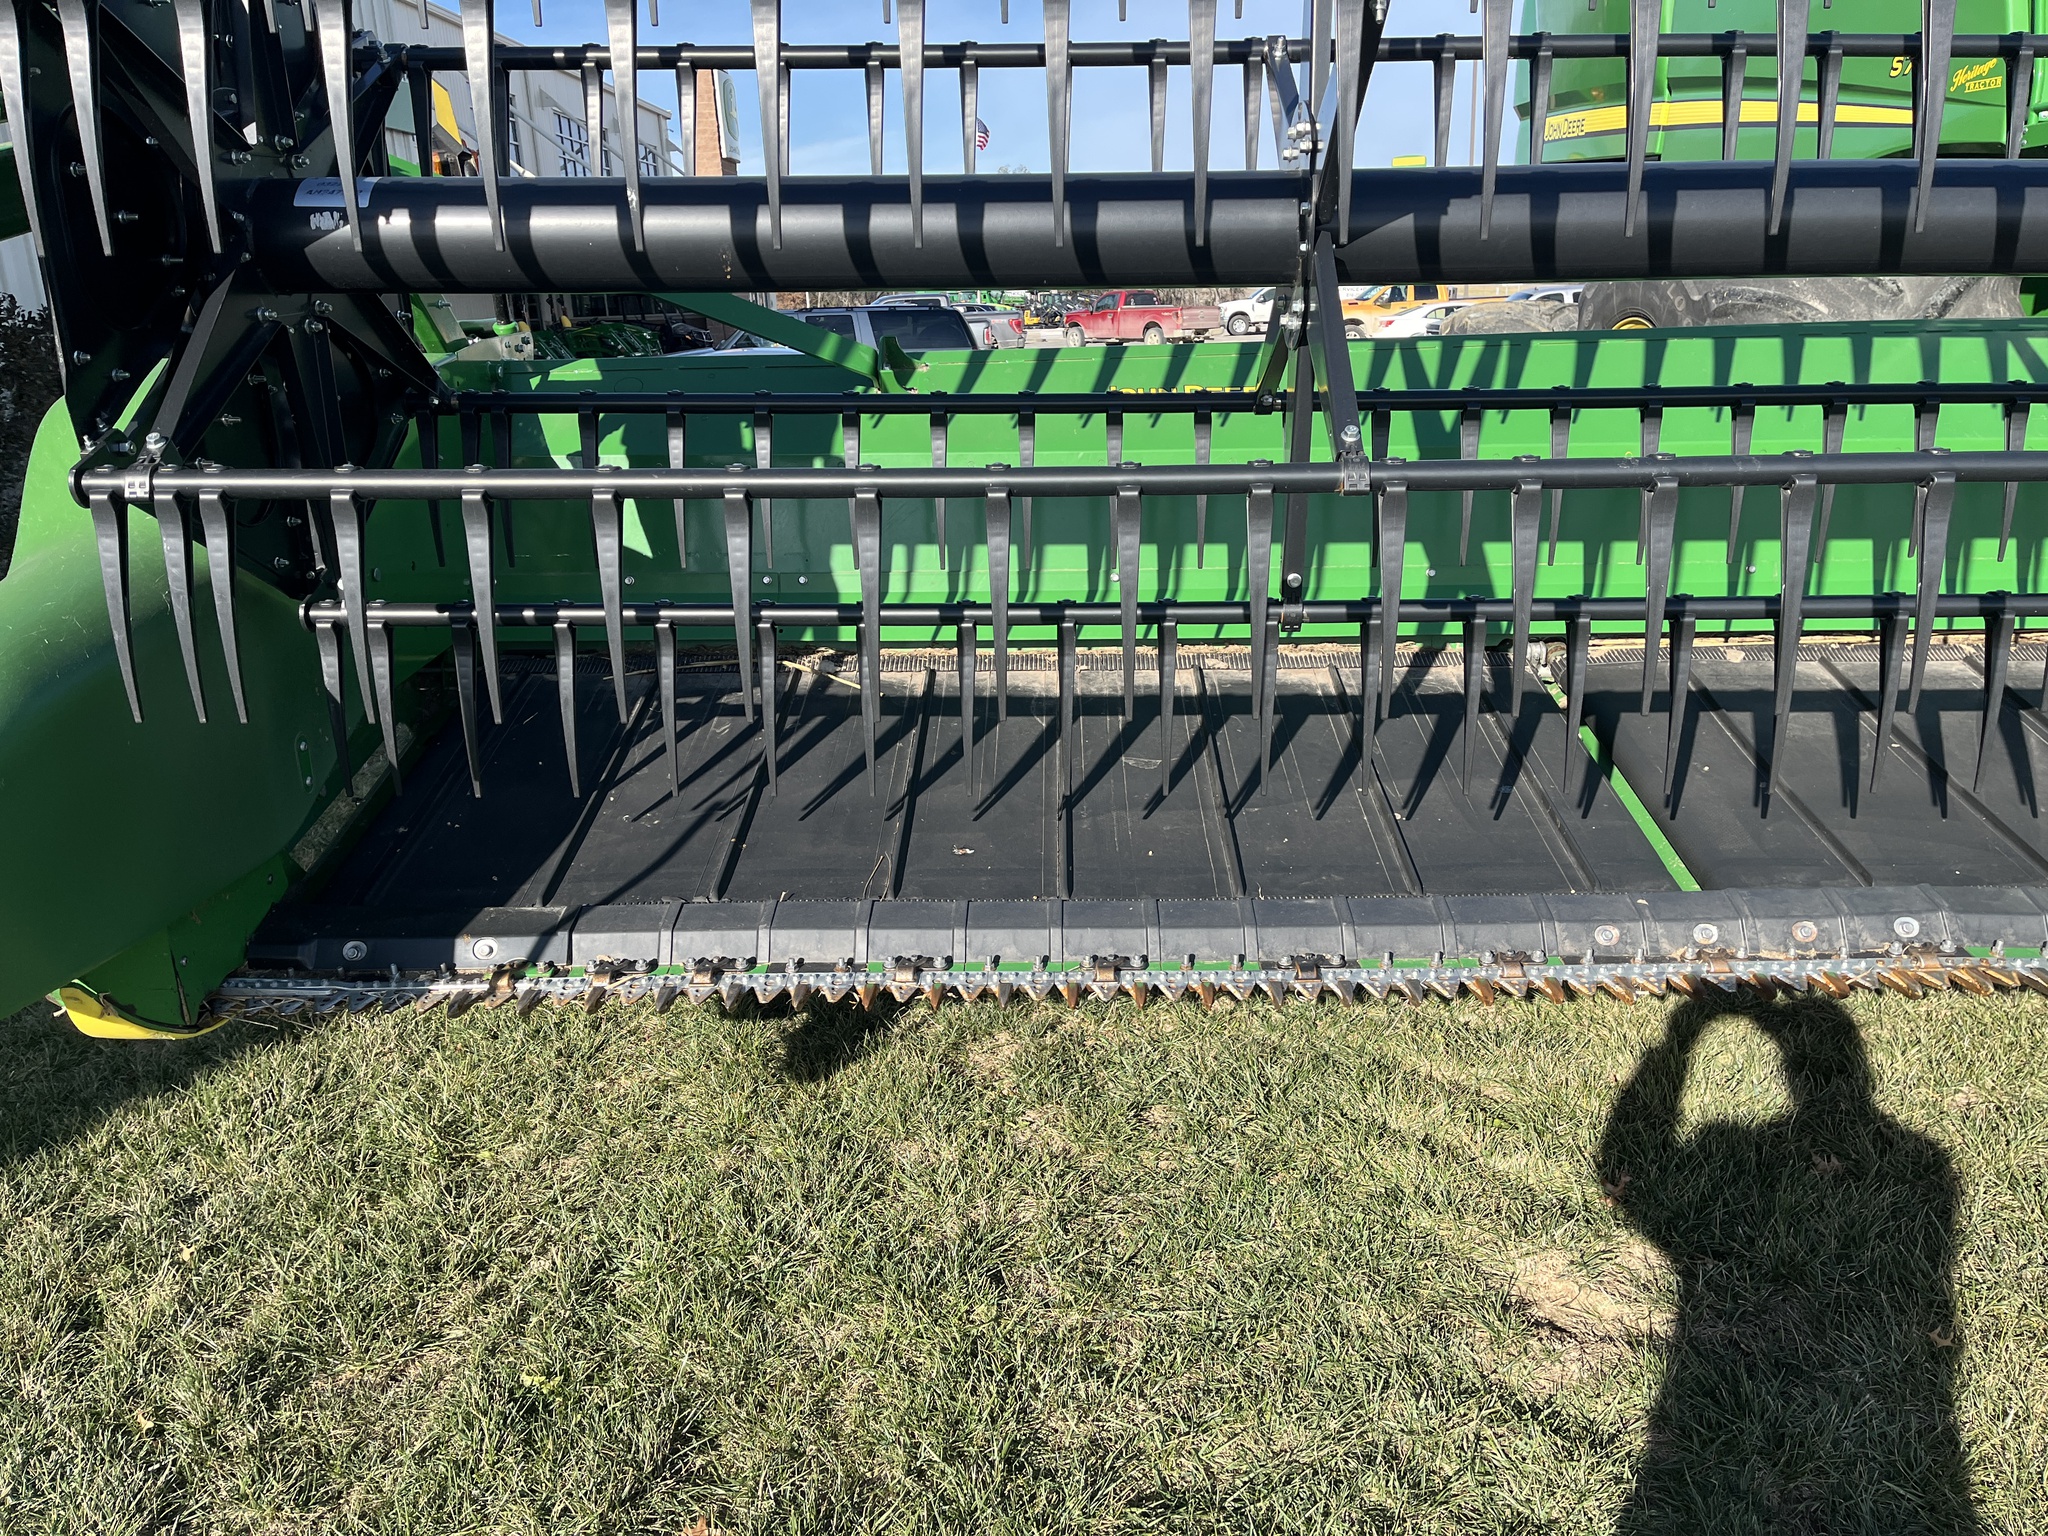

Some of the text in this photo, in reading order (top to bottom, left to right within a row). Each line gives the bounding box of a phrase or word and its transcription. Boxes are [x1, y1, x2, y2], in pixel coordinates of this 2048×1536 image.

[1950, 57, 1998, 92] Heritage
[1964, 77, 2003, 93] TRACTOR
[1544, 118, 1586, 141] JOHN DEERE
